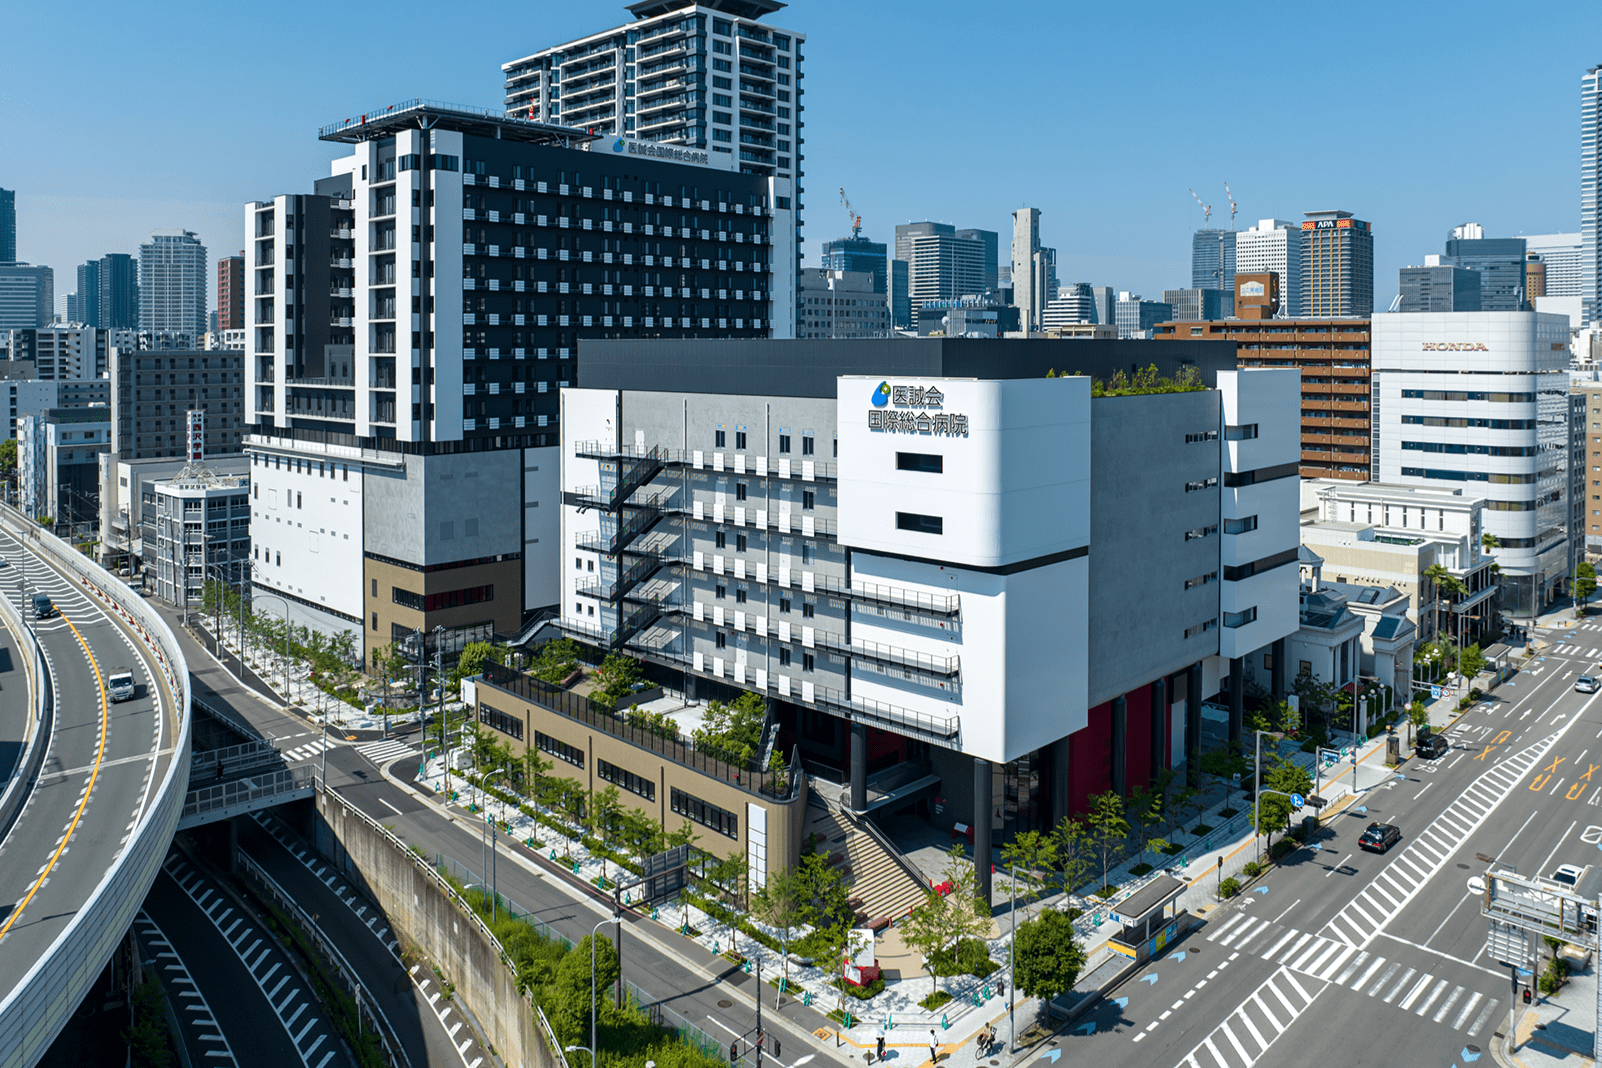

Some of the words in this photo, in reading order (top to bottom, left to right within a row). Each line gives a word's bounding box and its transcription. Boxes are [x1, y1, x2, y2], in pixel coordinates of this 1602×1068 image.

[628, 141, 709, 165] 医誠会国際総合病院
[1317, 220, 1334, 228] APA
[1422, 342, 1489, 351] HONDA
[892, 385, 943, 407] 医誠会
[867, 410, 968, 435] 国際総合病院
